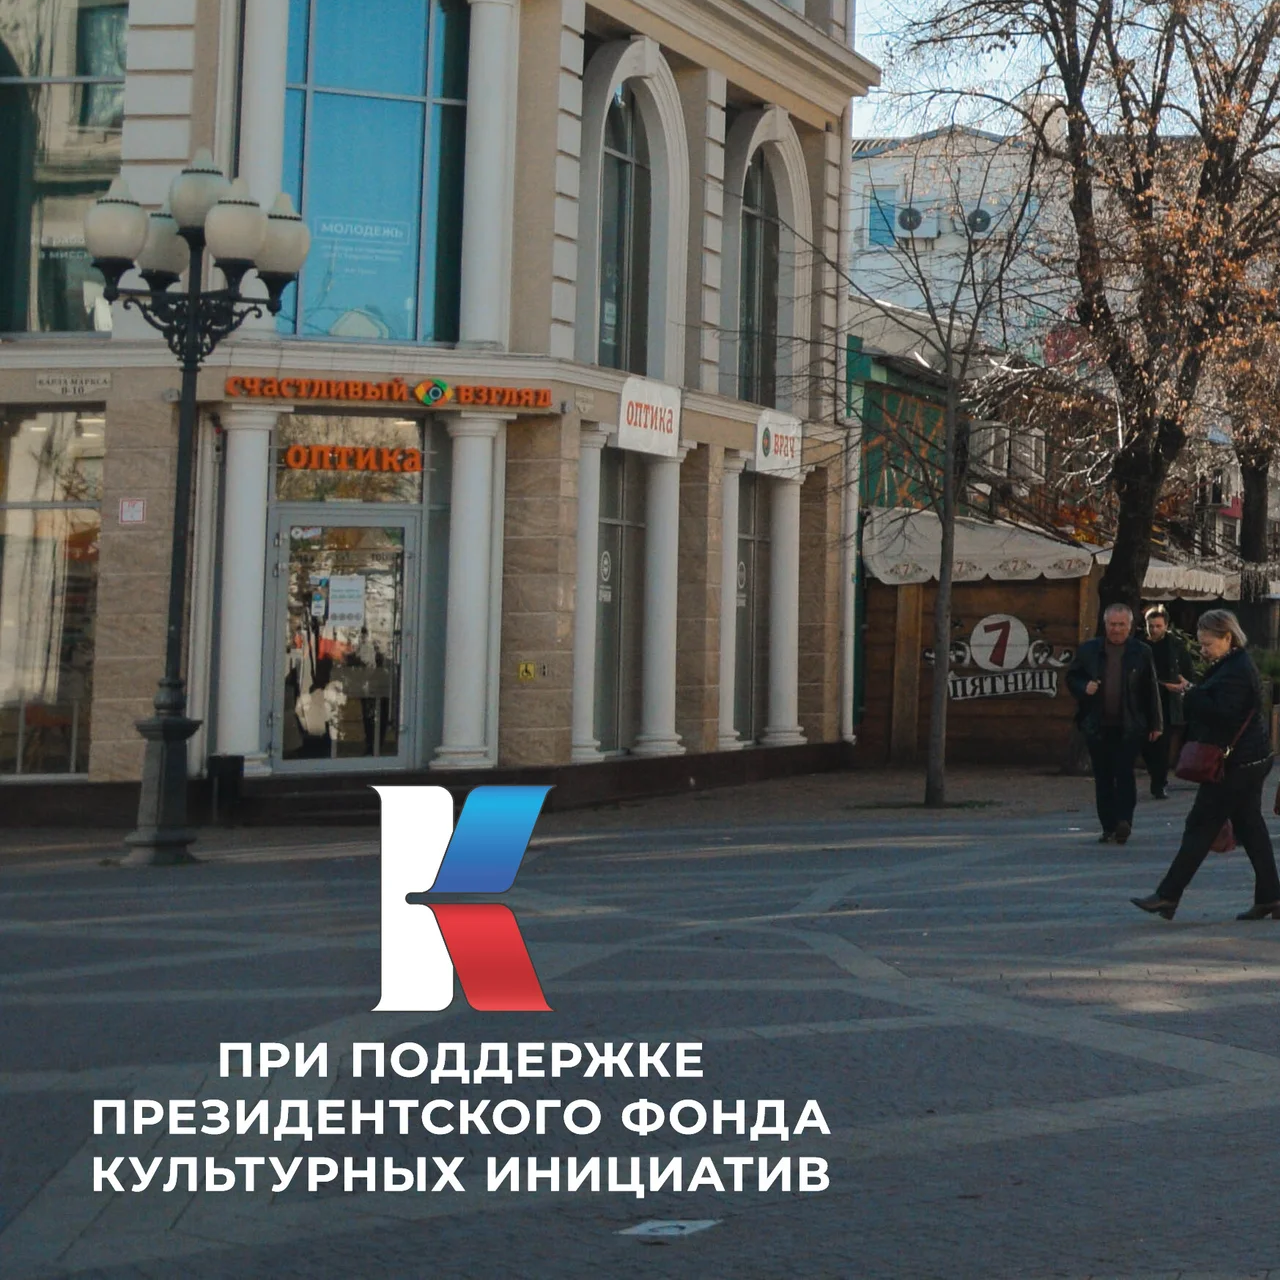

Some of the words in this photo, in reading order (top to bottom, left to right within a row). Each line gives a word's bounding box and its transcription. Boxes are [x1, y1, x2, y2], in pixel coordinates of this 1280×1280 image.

[225, 375, 408, 401] счастливый
[456, 385, 552, 408] взгляд
[627, 400, 673, 434] оптика
[285, 445, 423, 473] оптика
[774, 433, 795, 458] врач
[957, 561, 964, 571] 7
[1012, 560, 1019, 570] 7
[1066, 559, 1074, 569] 7
[984, 620, 1011, 667] 7
[950, 671, 1056, 698] ПЯТНИЦ
